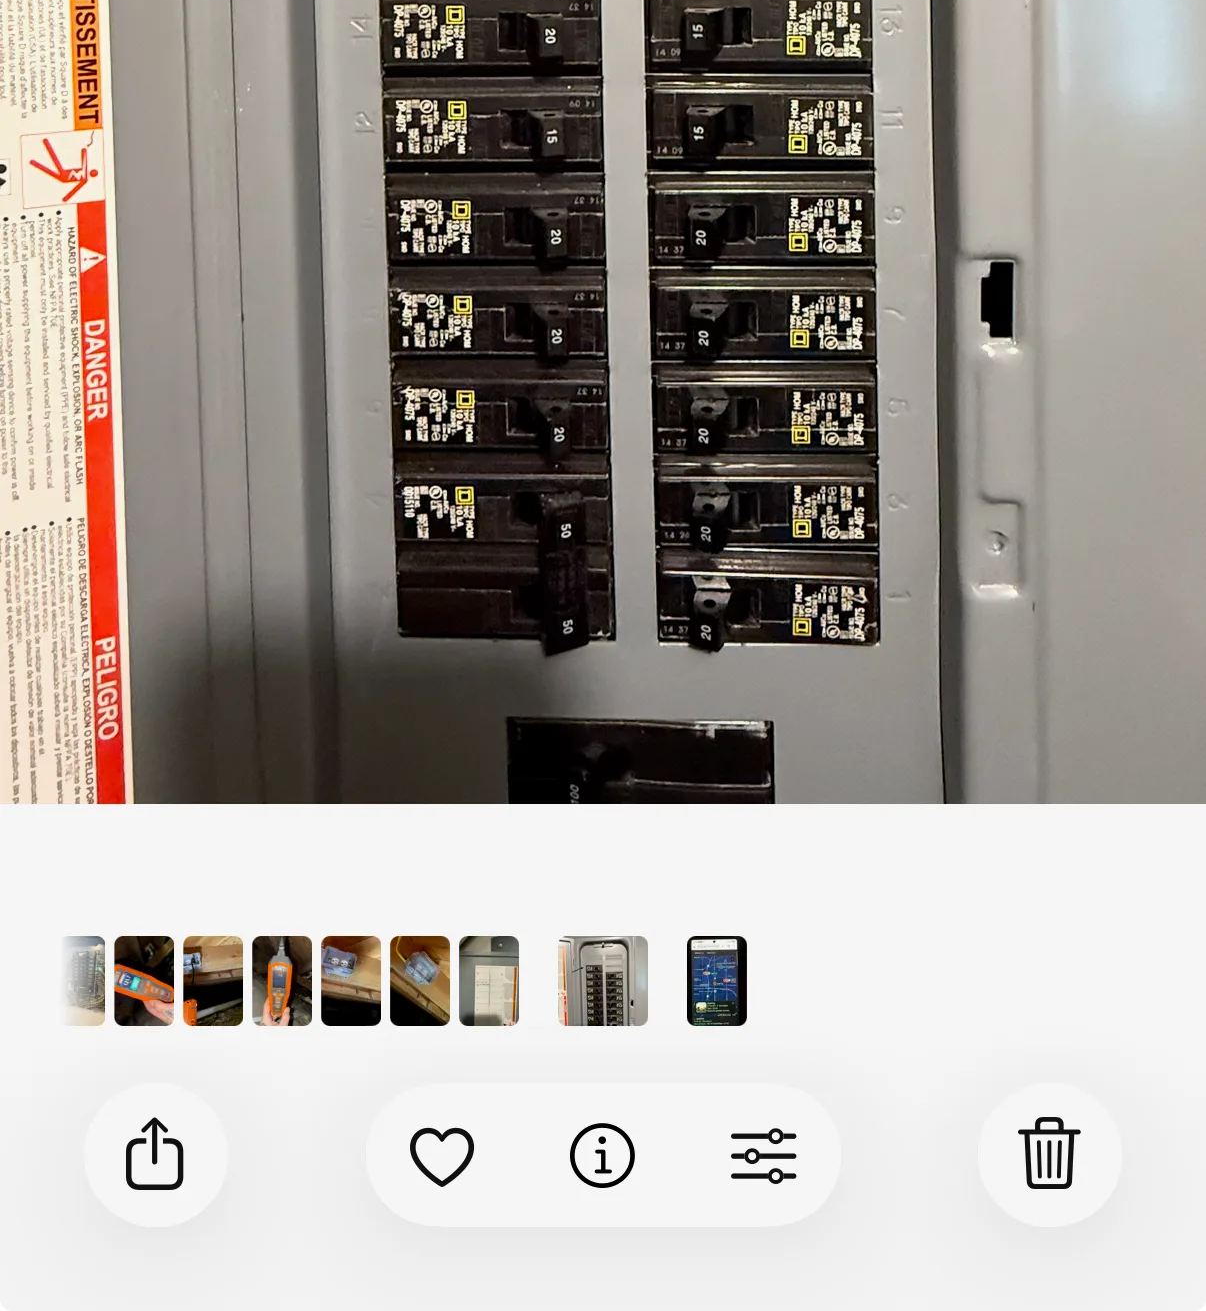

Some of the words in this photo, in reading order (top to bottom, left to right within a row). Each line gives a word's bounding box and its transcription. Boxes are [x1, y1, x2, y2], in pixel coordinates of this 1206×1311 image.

[789, 1, 797, 19] HOM
[444, 25, 454, 37] 10
[544, 28, 556, 44] 20
[692, 23, 704, 39] 15
[798, 23, 807, 35] 10
[791, 100, 799, 118] HOM
[351, 111, 377, 135] 12
[880, 106, 904, 129] 11
[446, 120, 456, 133] 10
[693, 126, 704, 141] 15
[800, 122, 809, 133] 10
[547, 129, 558, 144] 15
[883, 205, 906, 224] 9
[450, 220, 460, 233] 10
[801, 221, 809, 232] 10
[462, 236, 470, 254] HOM
[550, 229, 562, 245] 20
[695, 229, 707, 246] 20
[67, 227, 76, 264] HAZARD
[68, 267, 77, 278] OF
[69, 281, 79, 324] ELECTRIC
[792, 295, 800, 313] HOM
[452, 315, 461, 327] 10
[801, 316, 810, 328] 10
[70, 327, 80, 361] SHOCK,
[551, 328, 563, 344] 20
[698, 330, 710, 346] 20
[84, 319, 108, 421] DANGER
[793, 392, 801, 409] HOM
[455, 410, 464, 422] 10
[803, 412, 812, 425] 10
[73, 419, 82, 432] OR
[554, 427, 565, 443] 20
[698, 428, 710, 444] 20
[74, 435, 83, 453] ARC
[75, 456, 84, 485] FLASH
[454, 506, 463, 519] 10
[804, 506, 813, 518] 10
[76, 517, 86, 556] PELIGRO
[466, 522, 474, 539] HOM
[560, 522, 572, 539] 50
[700, 525, 712, 542] 20
[78, 559, 87, 570] DE
[79, 573, 88, 622] DESCARGA
[805, 605, 813, 617] 10
[562, 619, 574, 635] 50
[701, 624, 712, 641] 20
[94, 636, 119, 740] PELIGRO
[84, 739, 94, 785] DESTELLO
[86, 786, 95, 805] POR
